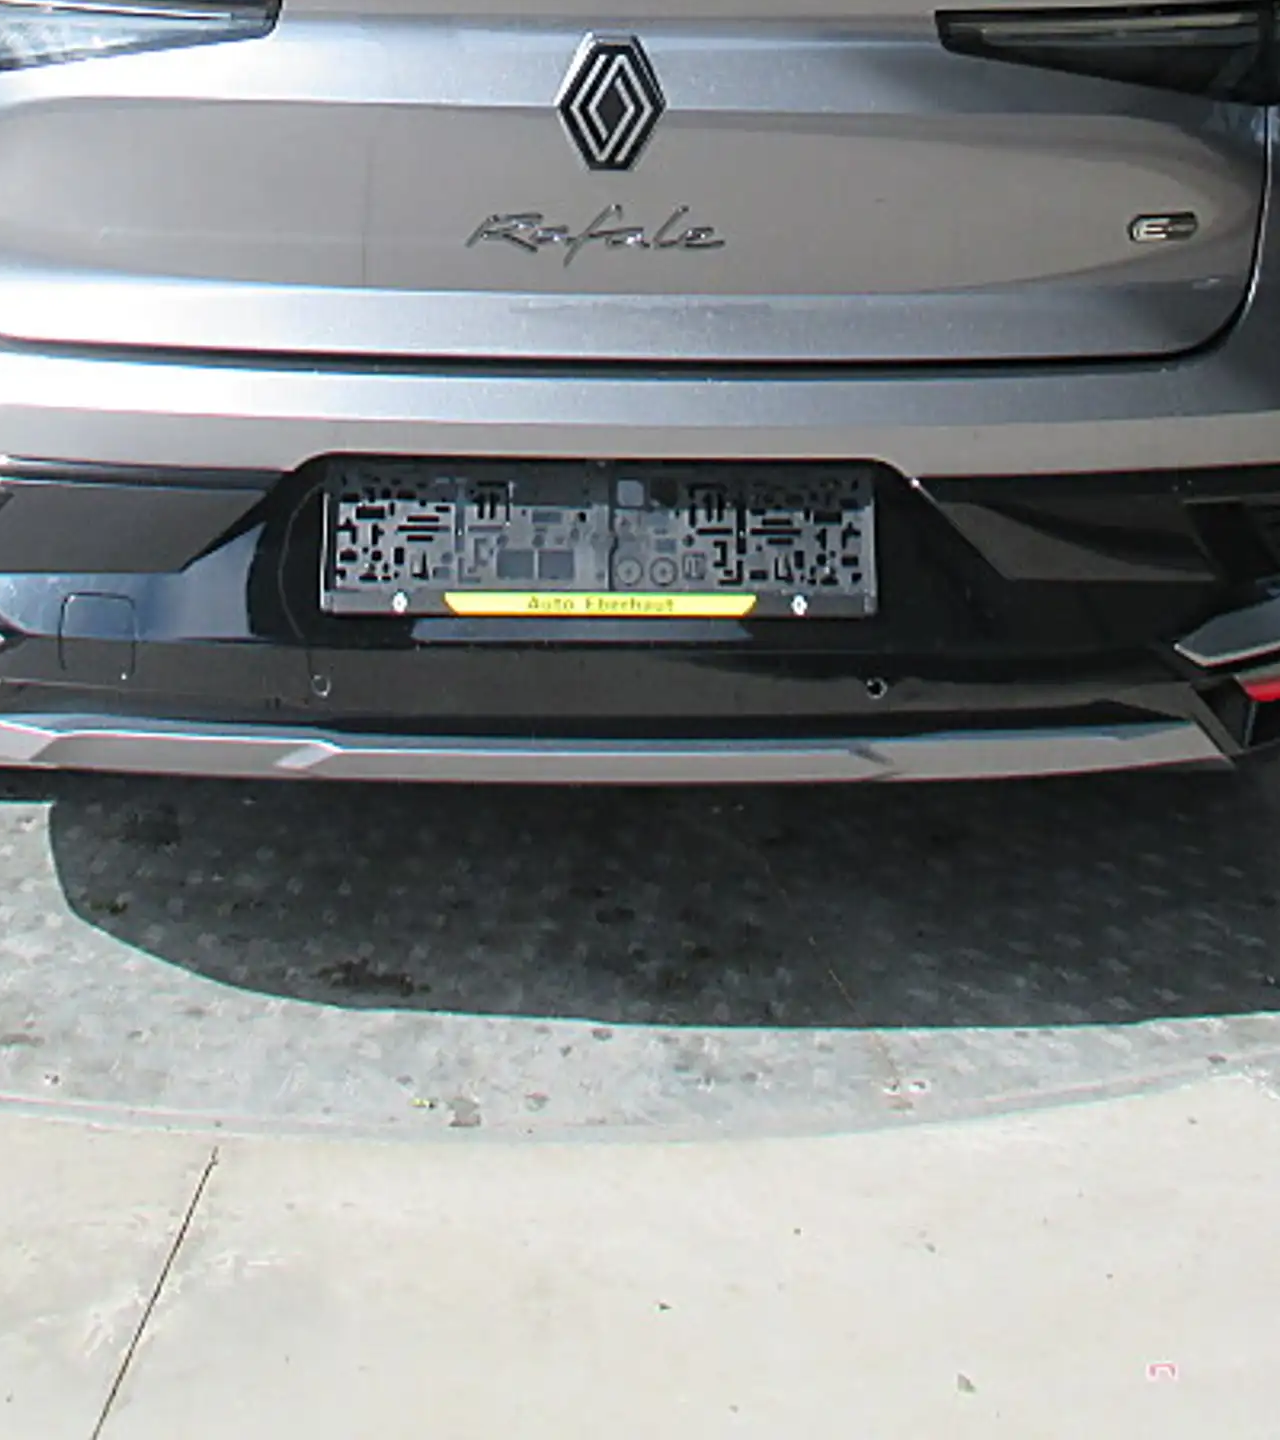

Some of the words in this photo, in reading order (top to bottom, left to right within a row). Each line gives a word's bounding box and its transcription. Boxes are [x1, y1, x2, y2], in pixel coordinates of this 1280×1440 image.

[465, 204, 725, 267] Rafale
[528, 596, 575, 610] Auto
[585, 596, 675, 611] Eberhaut
